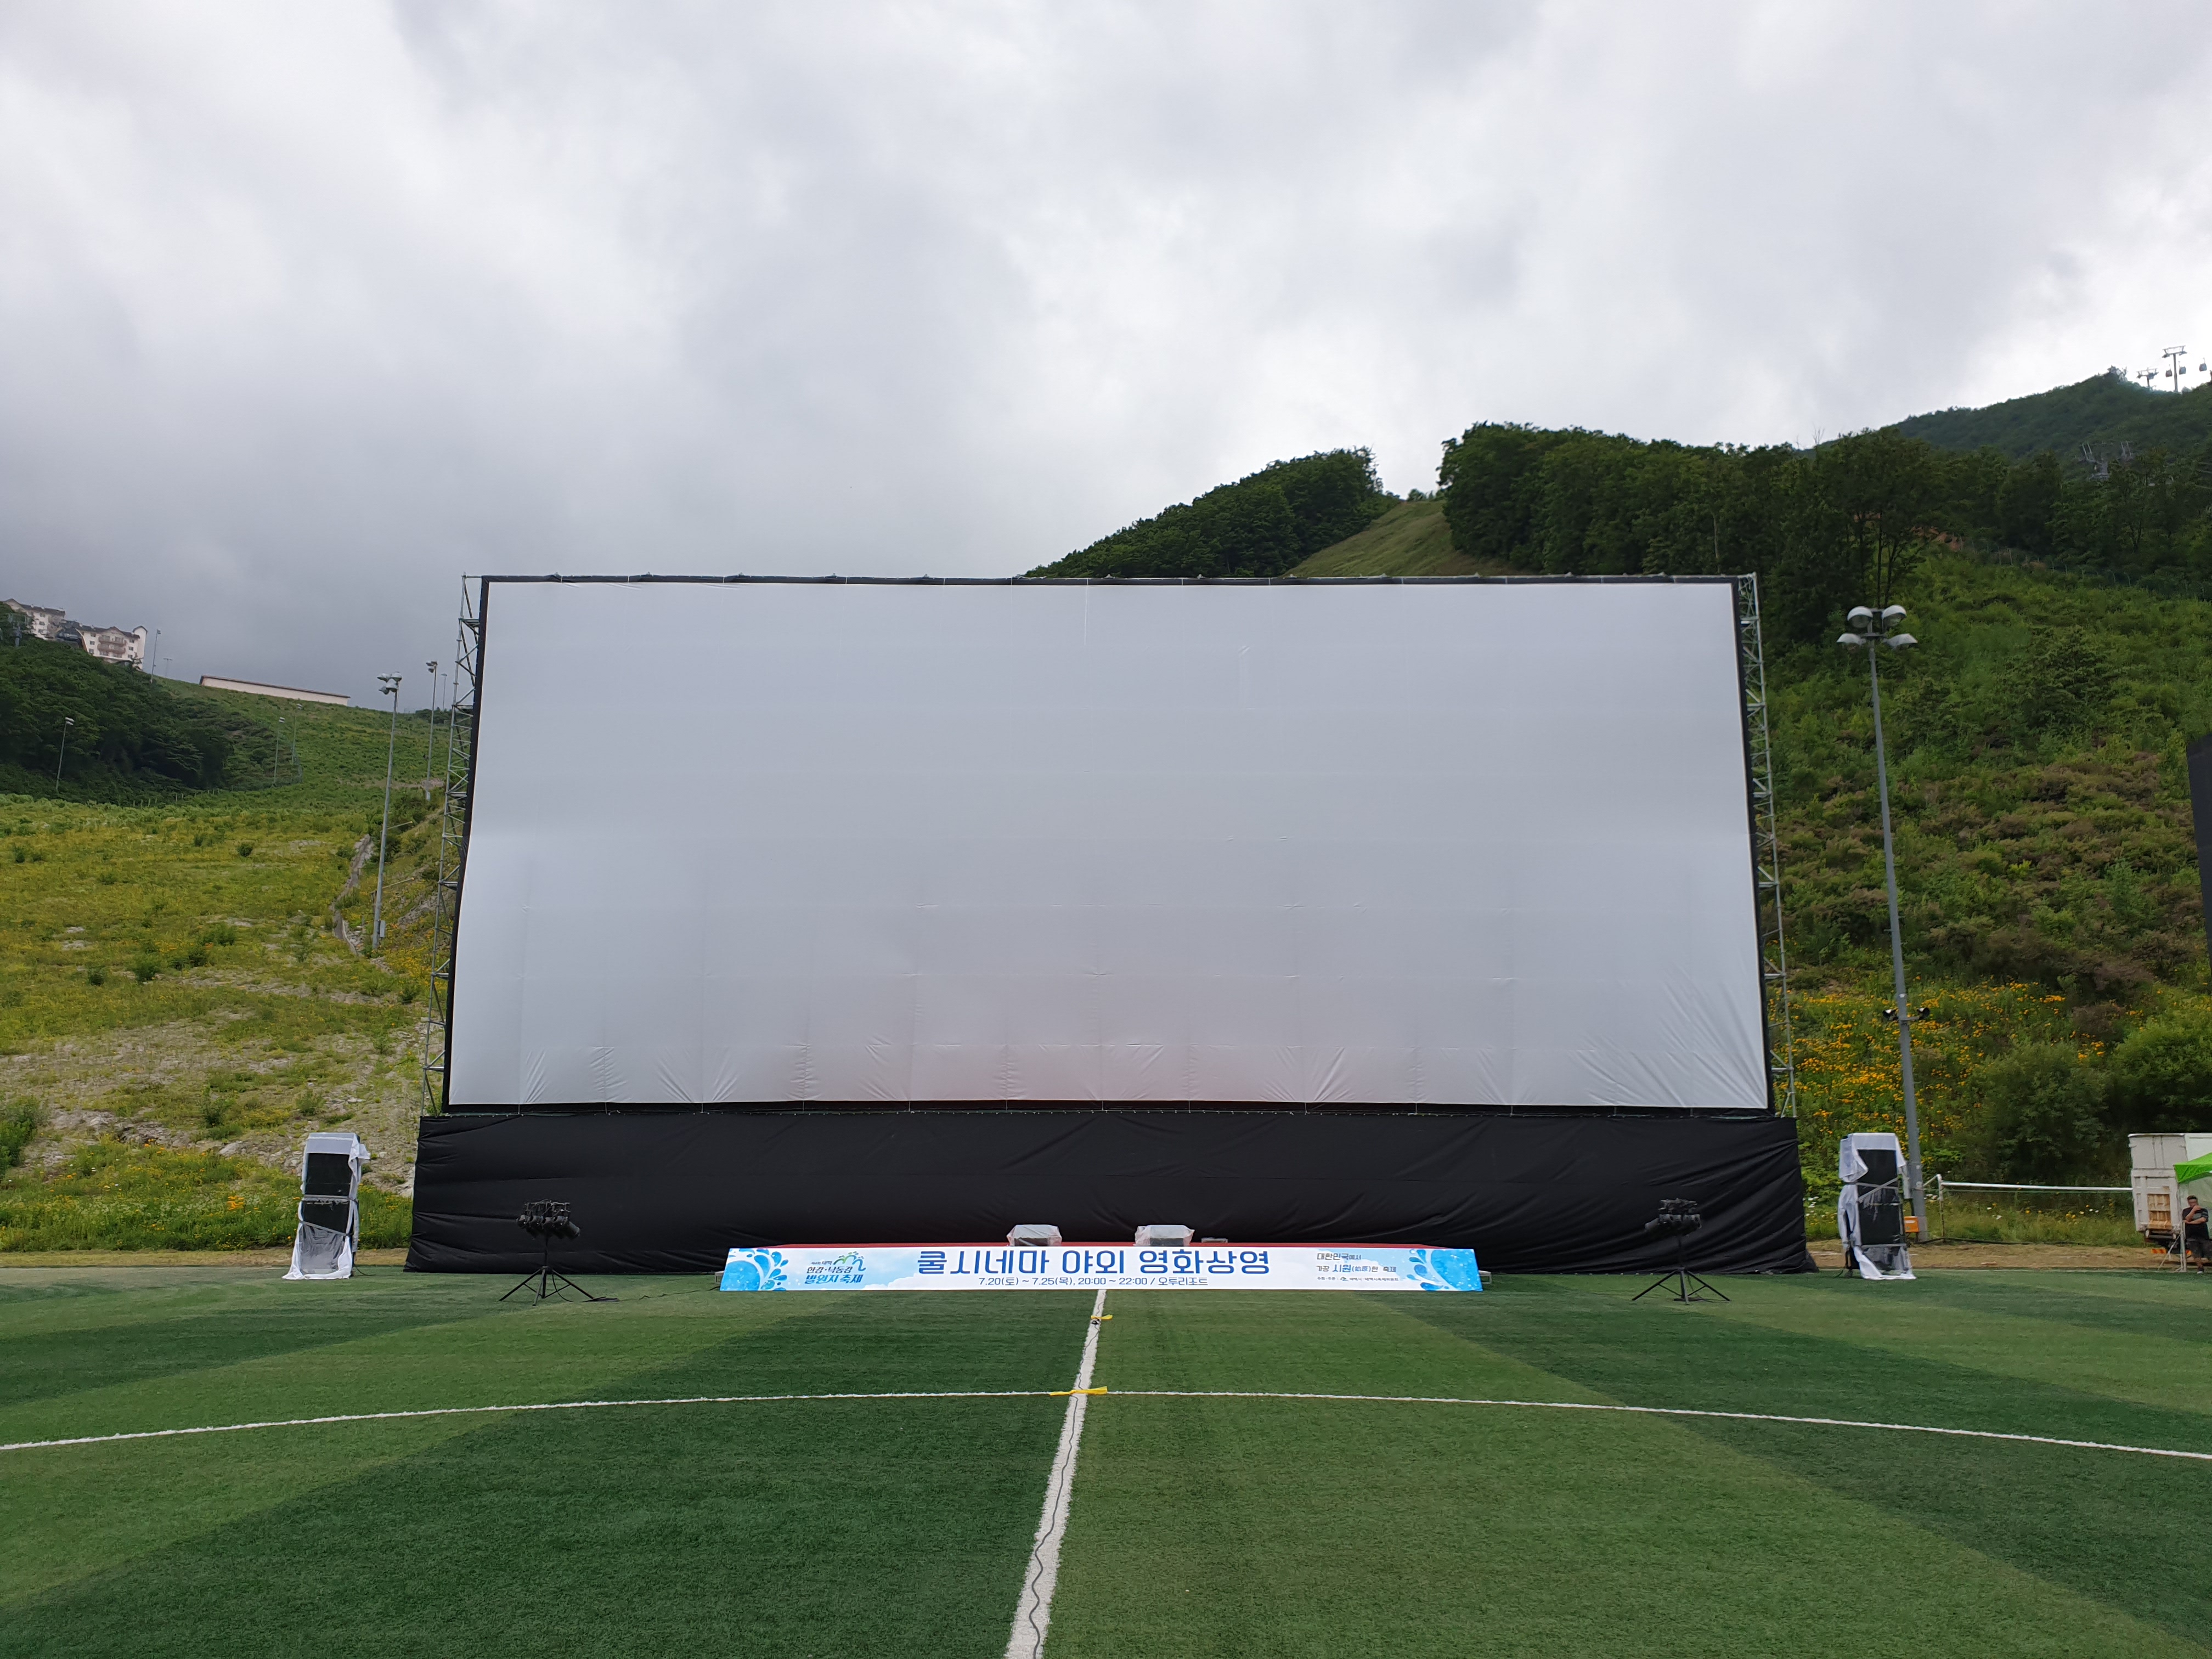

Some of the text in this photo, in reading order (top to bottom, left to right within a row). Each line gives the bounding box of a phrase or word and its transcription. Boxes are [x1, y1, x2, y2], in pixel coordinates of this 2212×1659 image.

[1063, 1250, 1124, 1274] 야외
[1139, 1249, 1269, 1274] 영화상영
[840, 1274, 864, 1283] 축제
[979, 1277, 1019, 1286] 7.20(토)
[1079, 1277, 1106, 1285] 20:00
[1119, 1277, 1148, 1285] 22:00
[1158, 1277, 1209, 1285] 오투리조트
